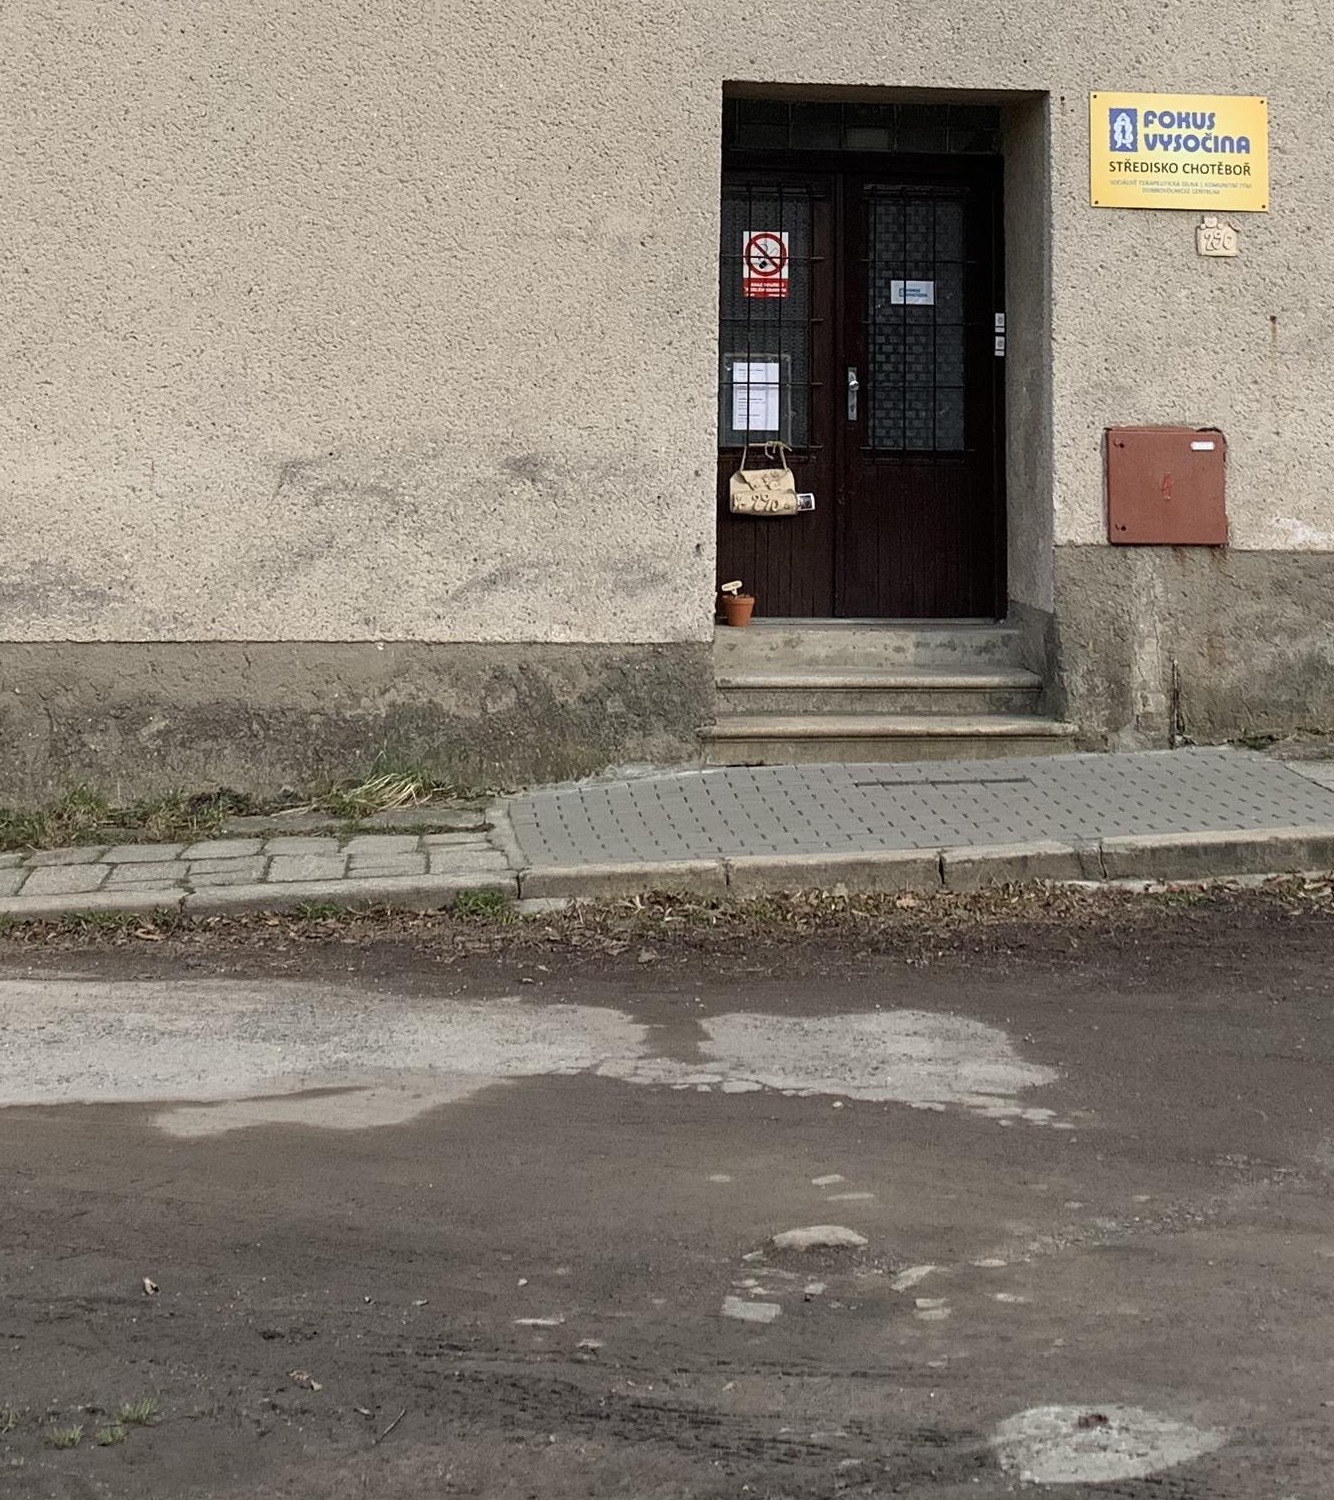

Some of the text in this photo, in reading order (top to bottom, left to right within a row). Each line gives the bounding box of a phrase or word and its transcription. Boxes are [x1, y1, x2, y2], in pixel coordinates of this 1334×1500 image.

[1143, 110, 1216, 130] FOKUS
[1144, 132, 1251, 154] VYSOČINA
[1109, 159, 1251, 176] STŘEDISKO CHOTĚBOŘ
